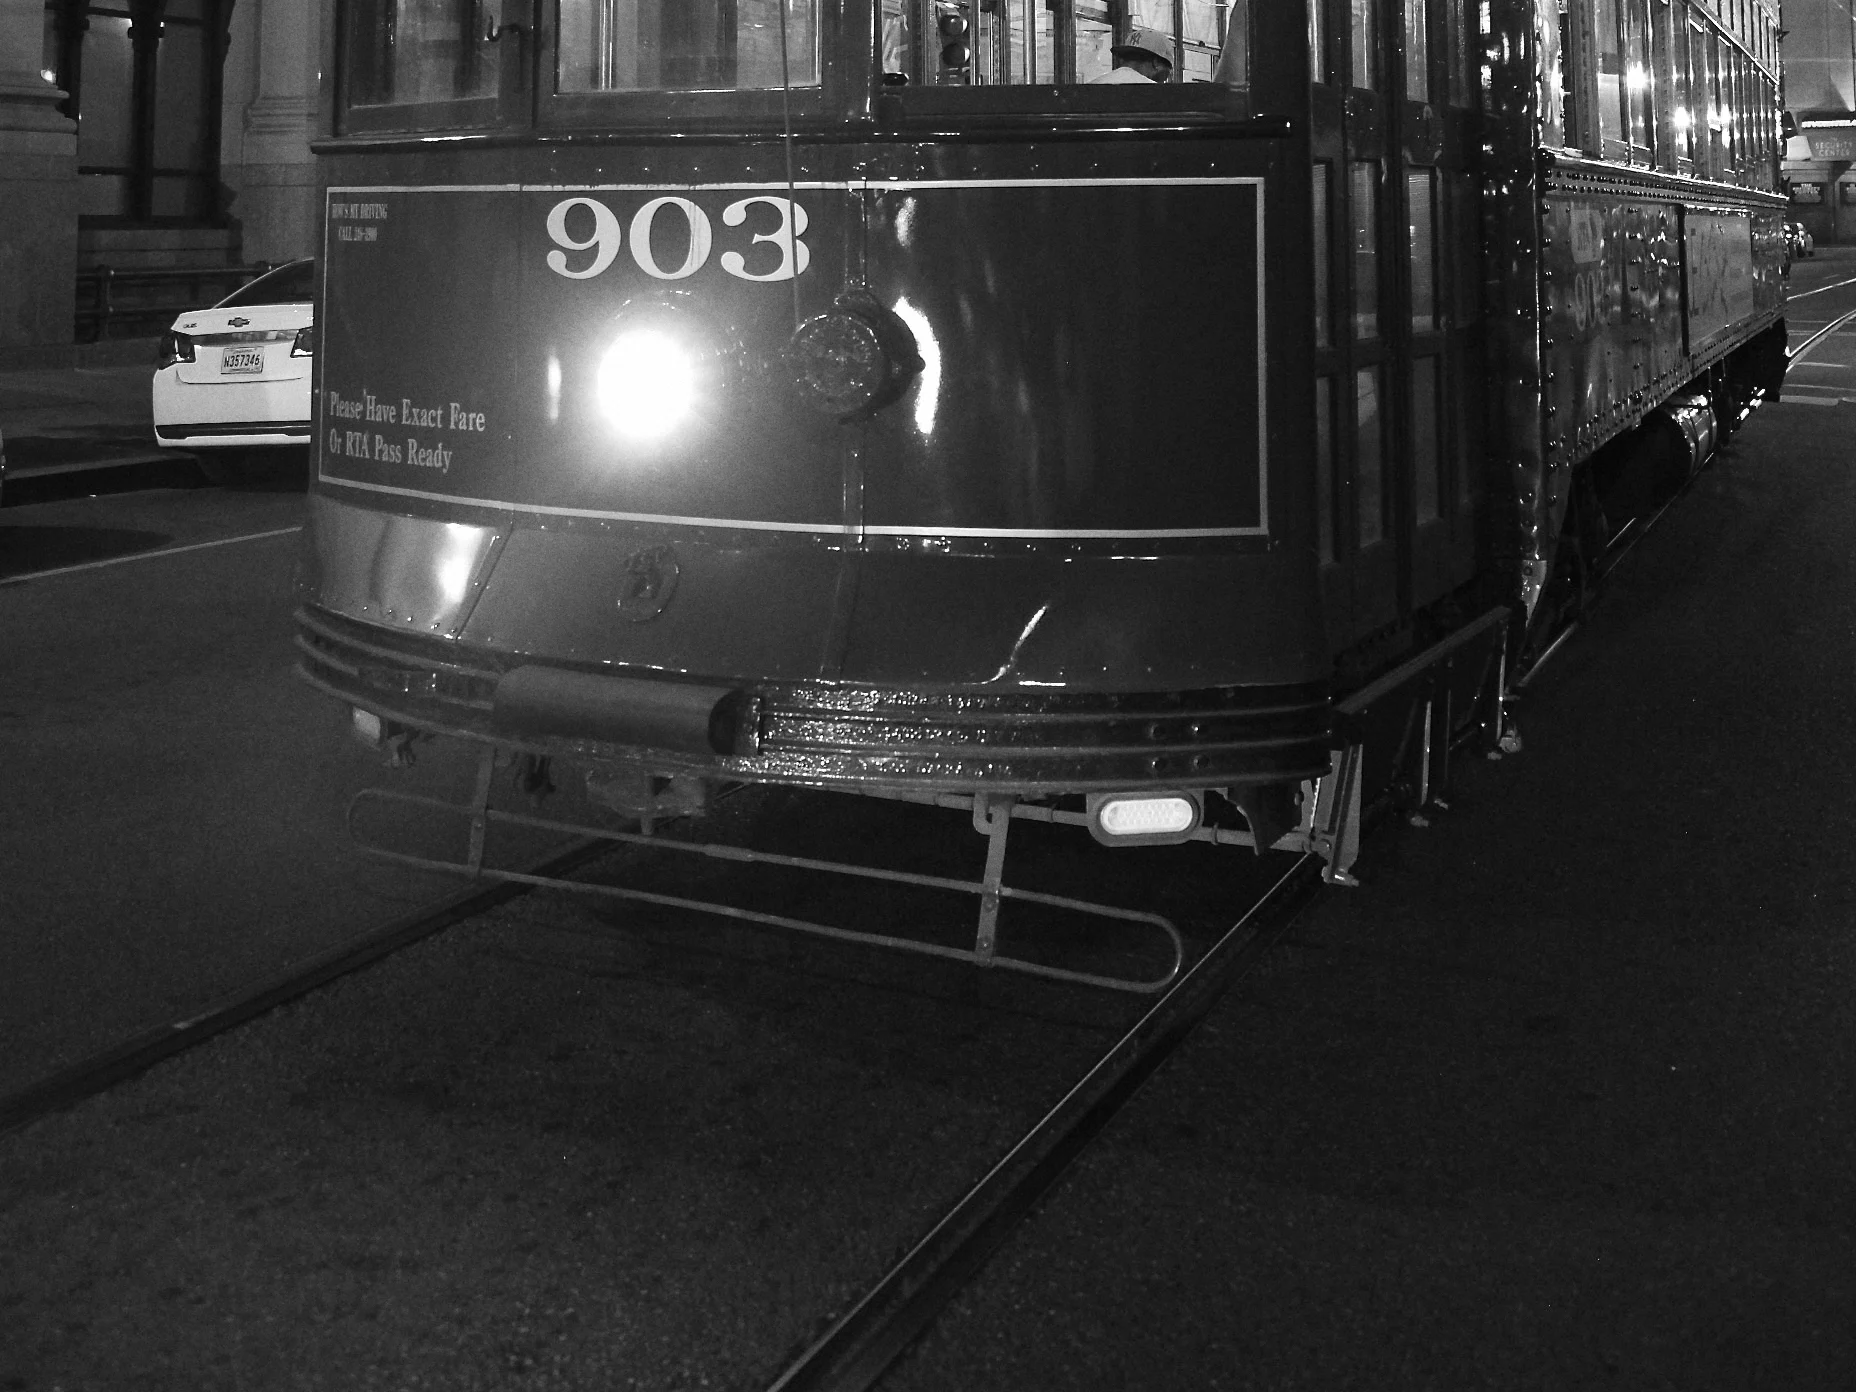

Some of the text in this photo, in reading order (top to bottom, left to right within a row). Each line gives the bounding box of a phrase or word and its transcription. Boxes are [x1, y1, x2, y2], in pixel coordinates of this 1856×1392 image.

[546, 195, 810, 282] 903
[330, 391, 486, 432] Please Have Exact Fare
[329, 428, 453, 474] Or RTA Pass Ready
